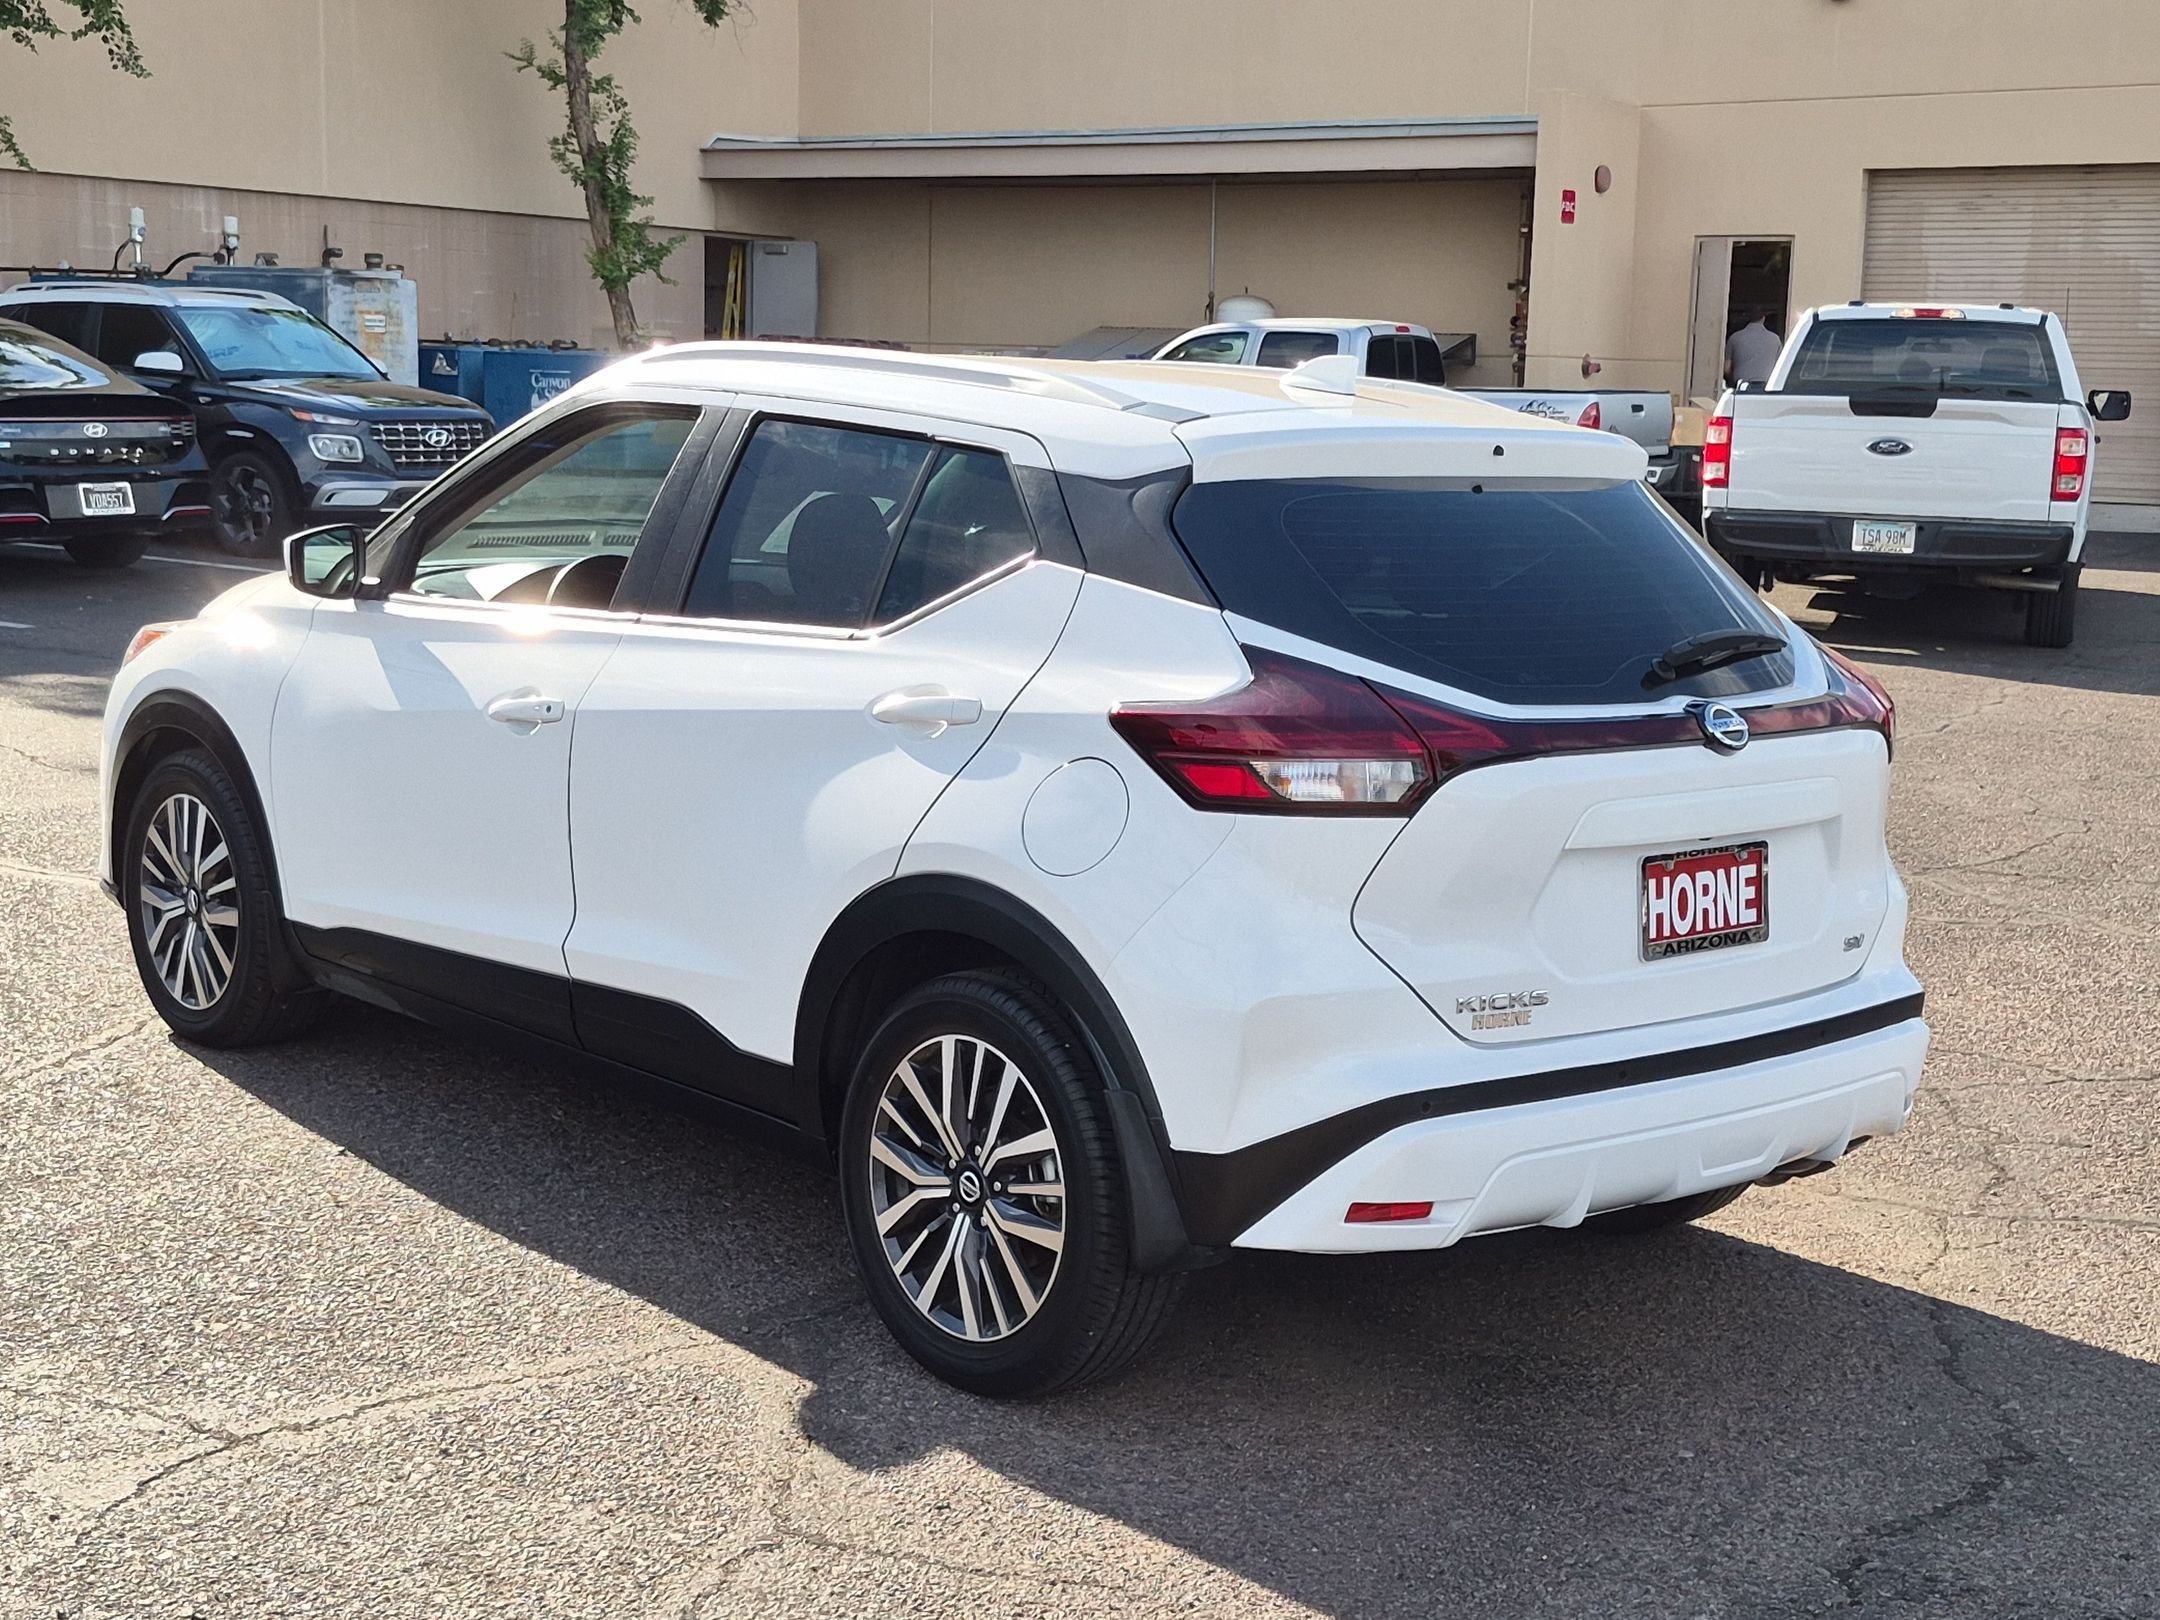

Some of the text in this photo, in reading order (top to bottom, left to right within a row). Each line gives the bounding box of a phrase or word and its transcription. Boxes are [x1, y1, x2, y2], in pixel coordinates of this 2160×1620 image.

[531, 373, 571, 390] Canyon
[1676, 846, 1737, 859] HORNE
[1648, 863, 1757, 940] HORNE
[1663, 930, 1752, 957] ARIZONA
[1842, 932, 1865, 952] SV
[1456, 989, 1549, 1014] KICKS
[1471, 1009, 1532, 1031] HORNE
